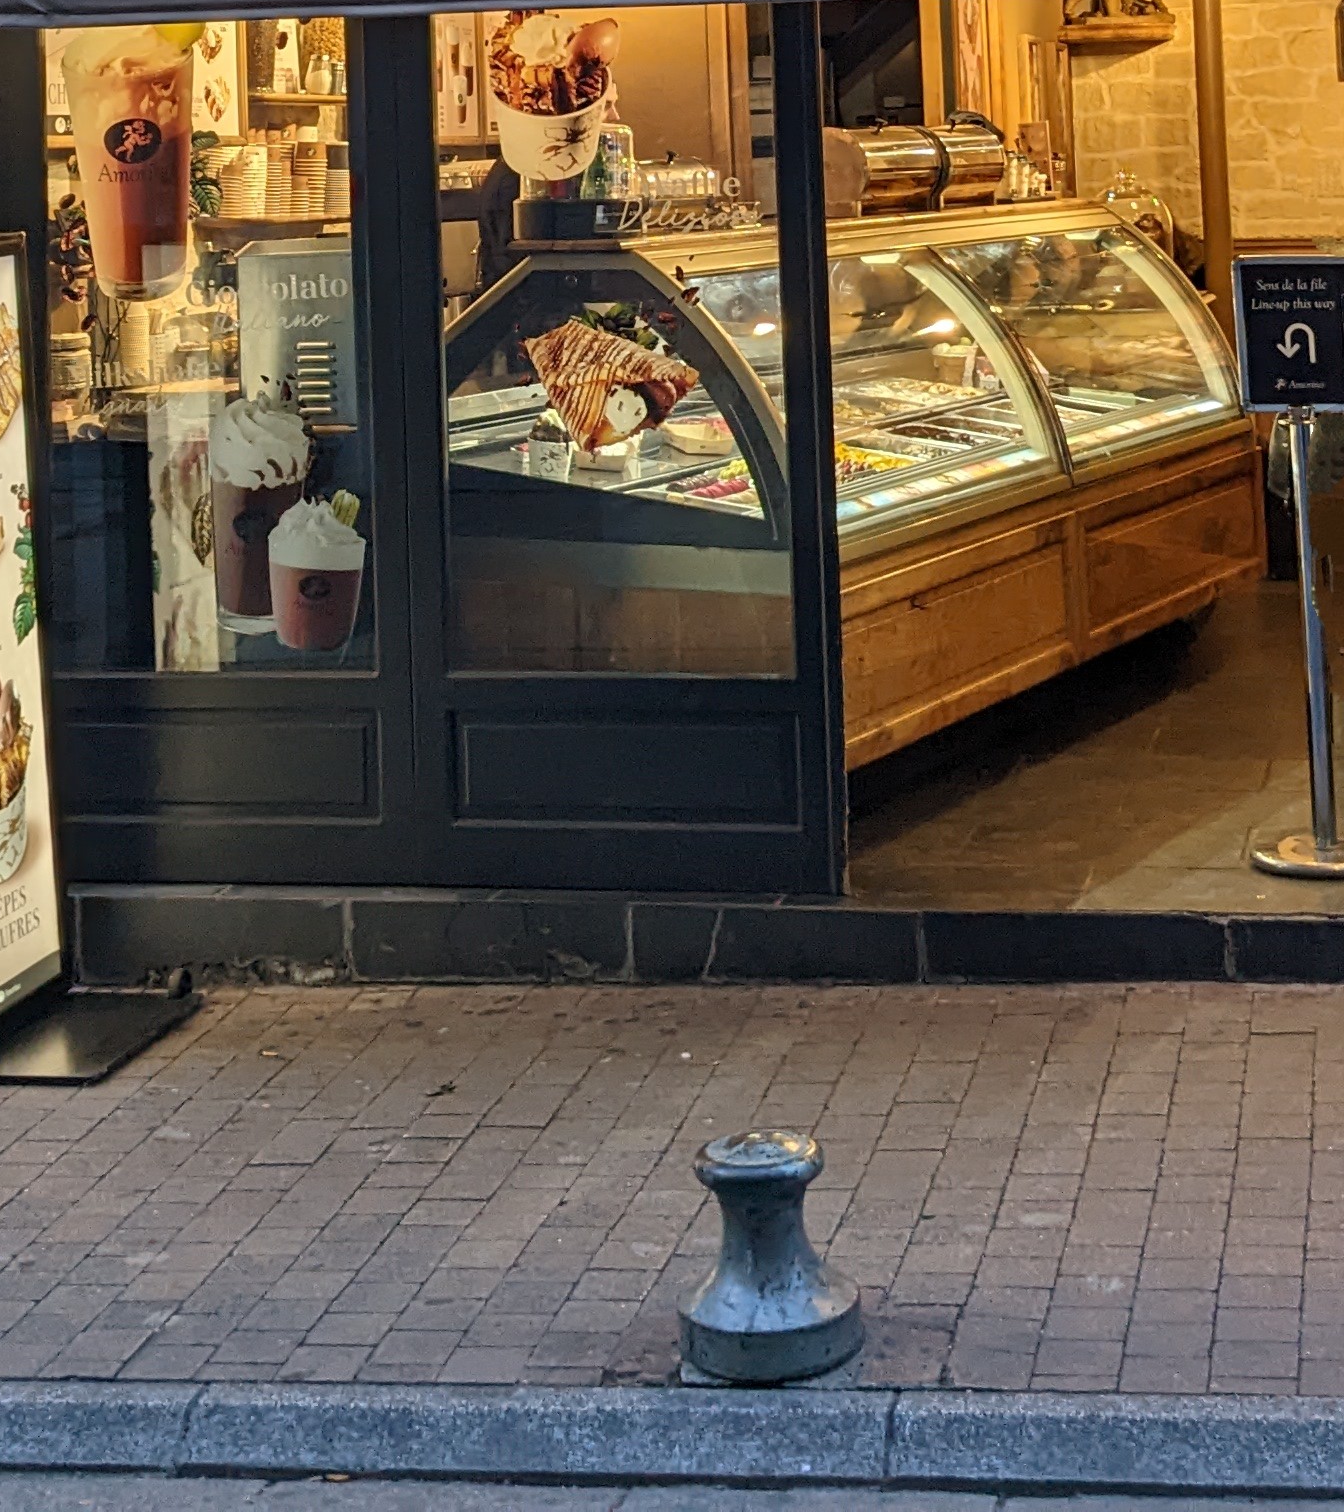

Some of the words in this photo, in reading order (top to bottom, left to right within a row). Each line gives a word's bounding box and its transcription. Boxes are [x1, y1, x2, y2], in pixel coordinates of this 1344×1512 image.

[97, 163, 176, 184] Amori
[186, 272, 349, 307] Cioolato
[1281, 278, 1295, 291] de
[1296, 278, 1308, 291] la
[1309, 278, 1328, 292] file
[1292, 297, 1312, 310] this
[1314, 299, 1336, 312] way
